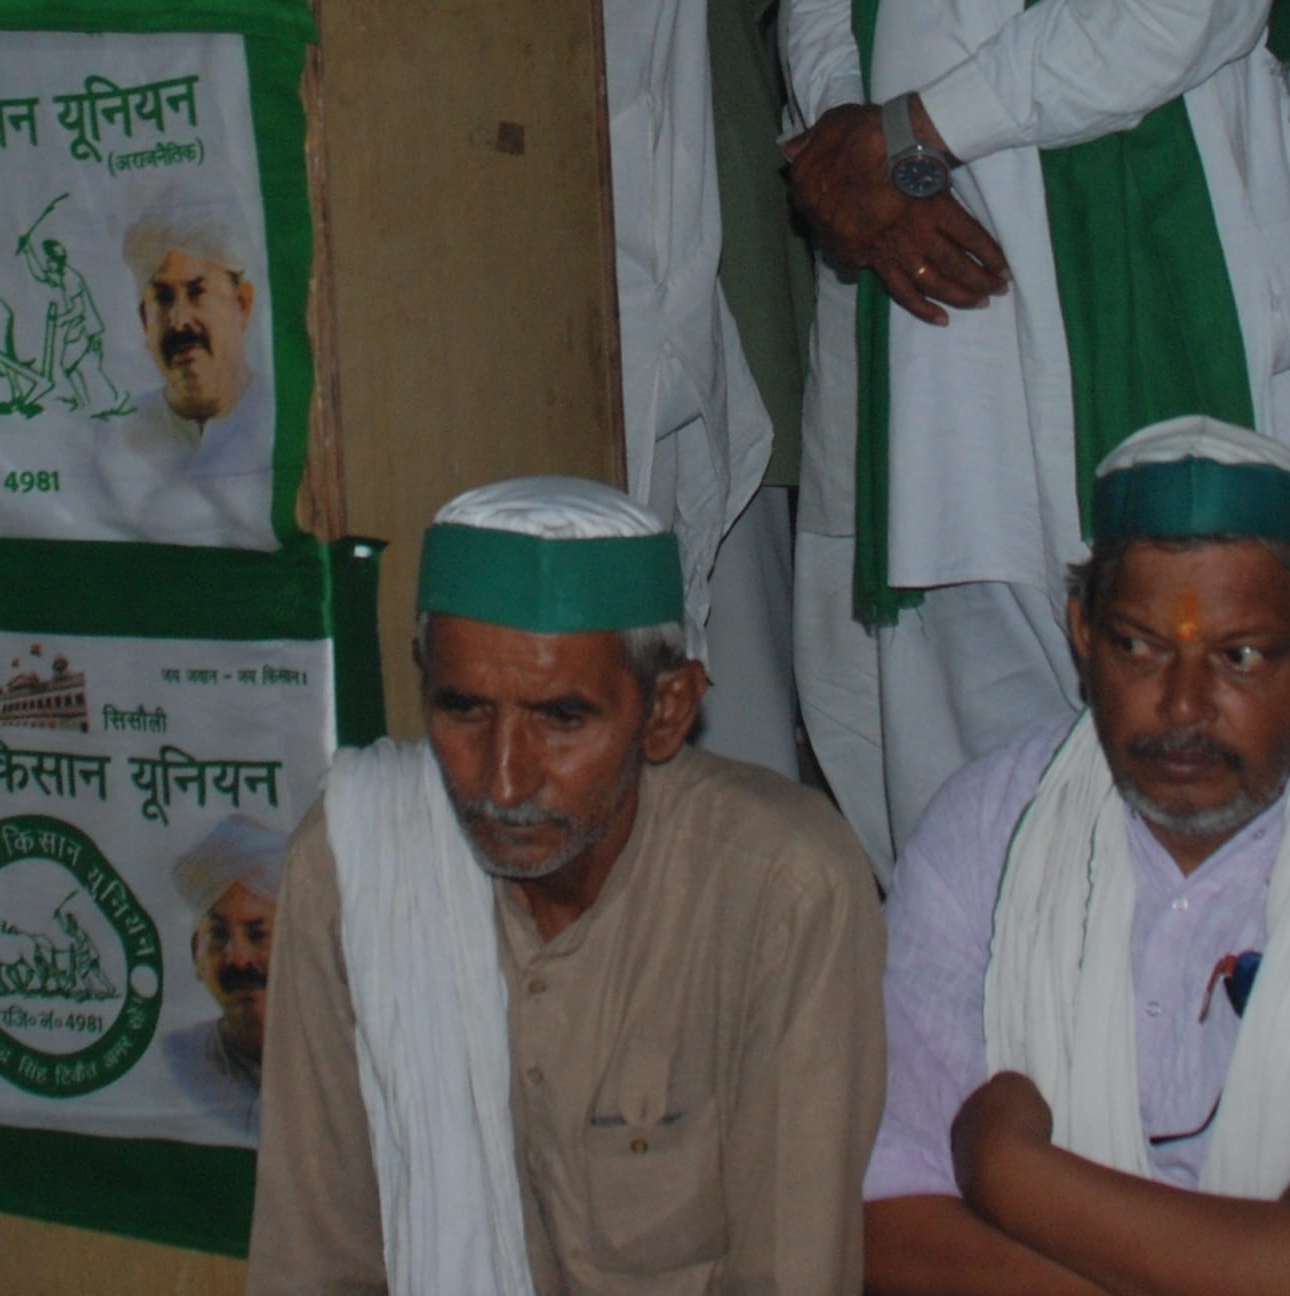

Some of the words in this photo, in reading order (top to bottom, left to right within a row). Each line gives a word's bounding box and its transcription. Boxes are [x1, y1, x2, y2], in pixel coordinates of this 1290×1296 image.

[53, 75, 199, 163] यूनियन
[107, 140, 205, 177] (अराजनैतिक)
[4, 470, 60, 493] 4981
[102, 704, 167, 734] सिसौली
[128, 745, 282, 825] यूनियन
[1, 824, 83, 867] किसान
[87, 866, 156, 956] यूनियन
[65, 1013, 103, 1033] 4981
